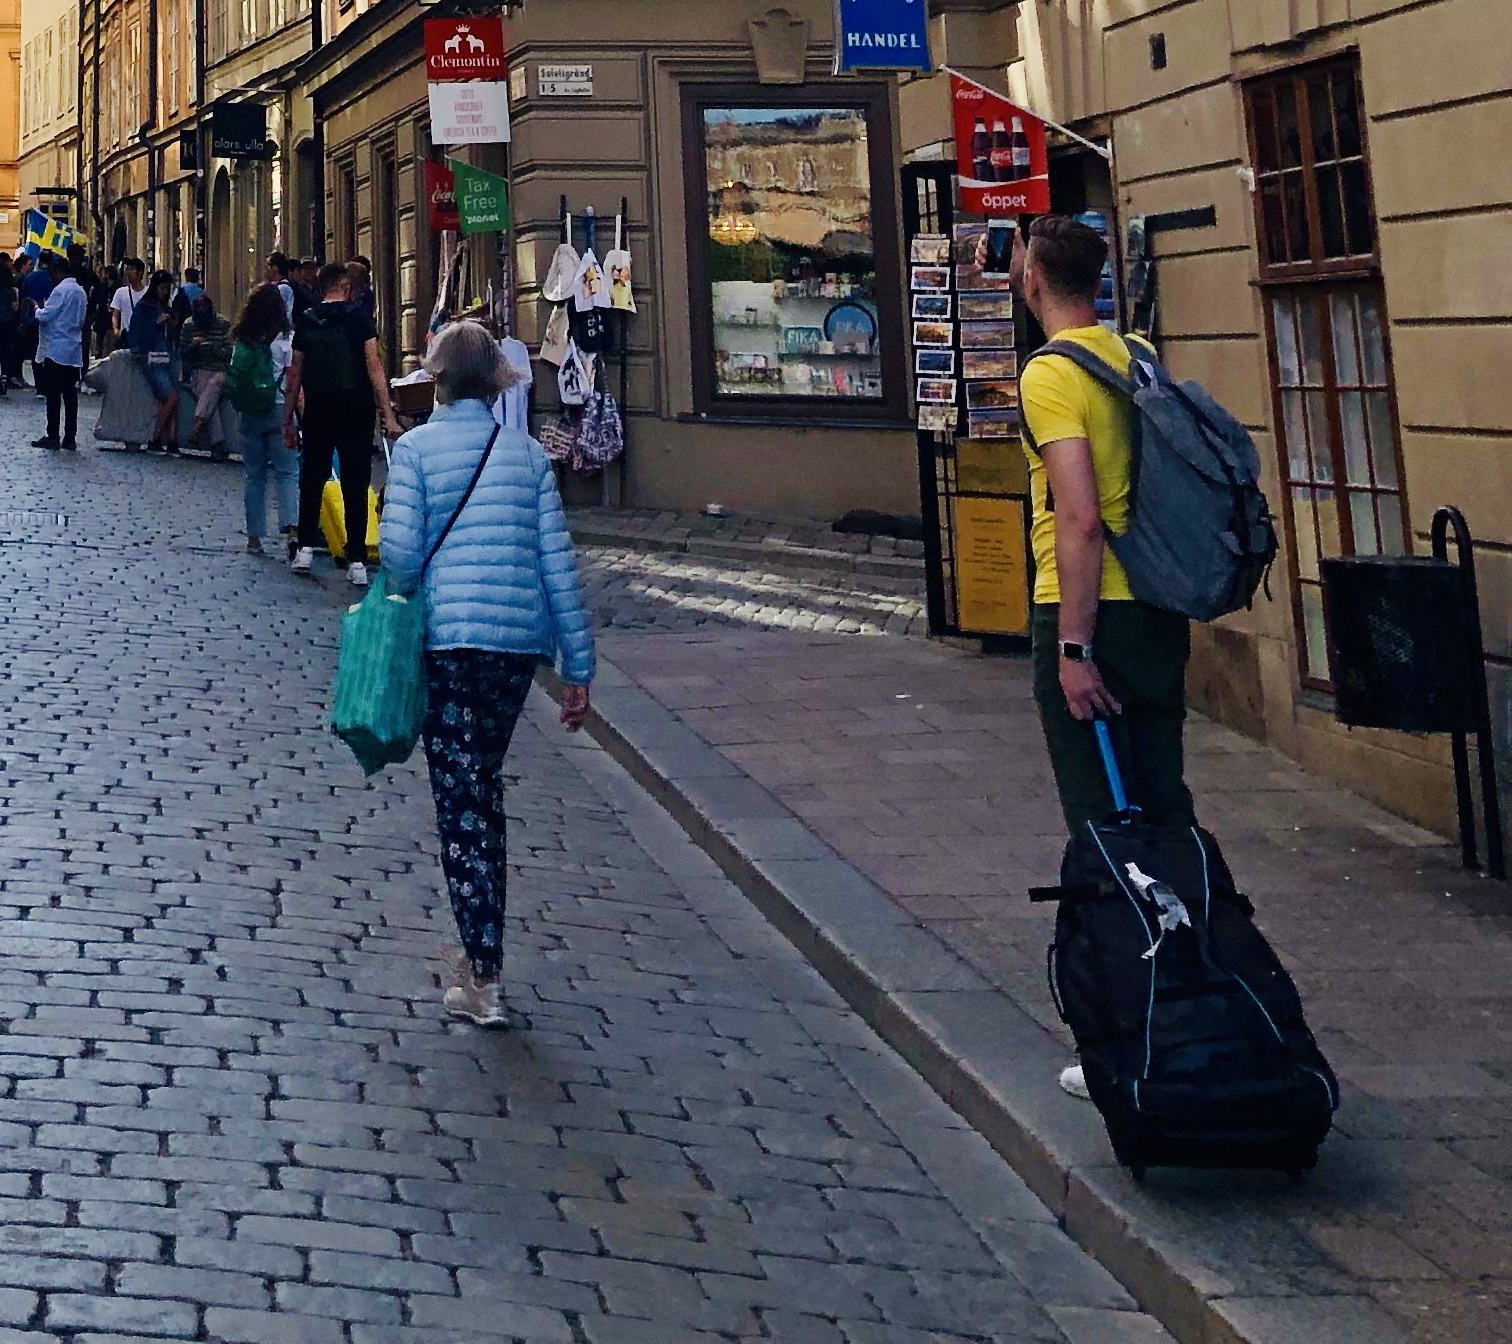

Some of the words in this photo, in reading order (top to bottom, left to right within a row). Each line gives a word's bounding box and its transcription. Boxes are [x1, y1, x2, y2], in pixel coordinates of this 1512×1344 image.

[847, 32, 921, 48] HANDEL
[430, 54, 500, 68] Clemontin
[465, 177, 491, 193] Tax
[463, 194, 497, 210] Free
[981, 192, 1027, 210] öppet
[788, 330, 819, 344] FIKA
